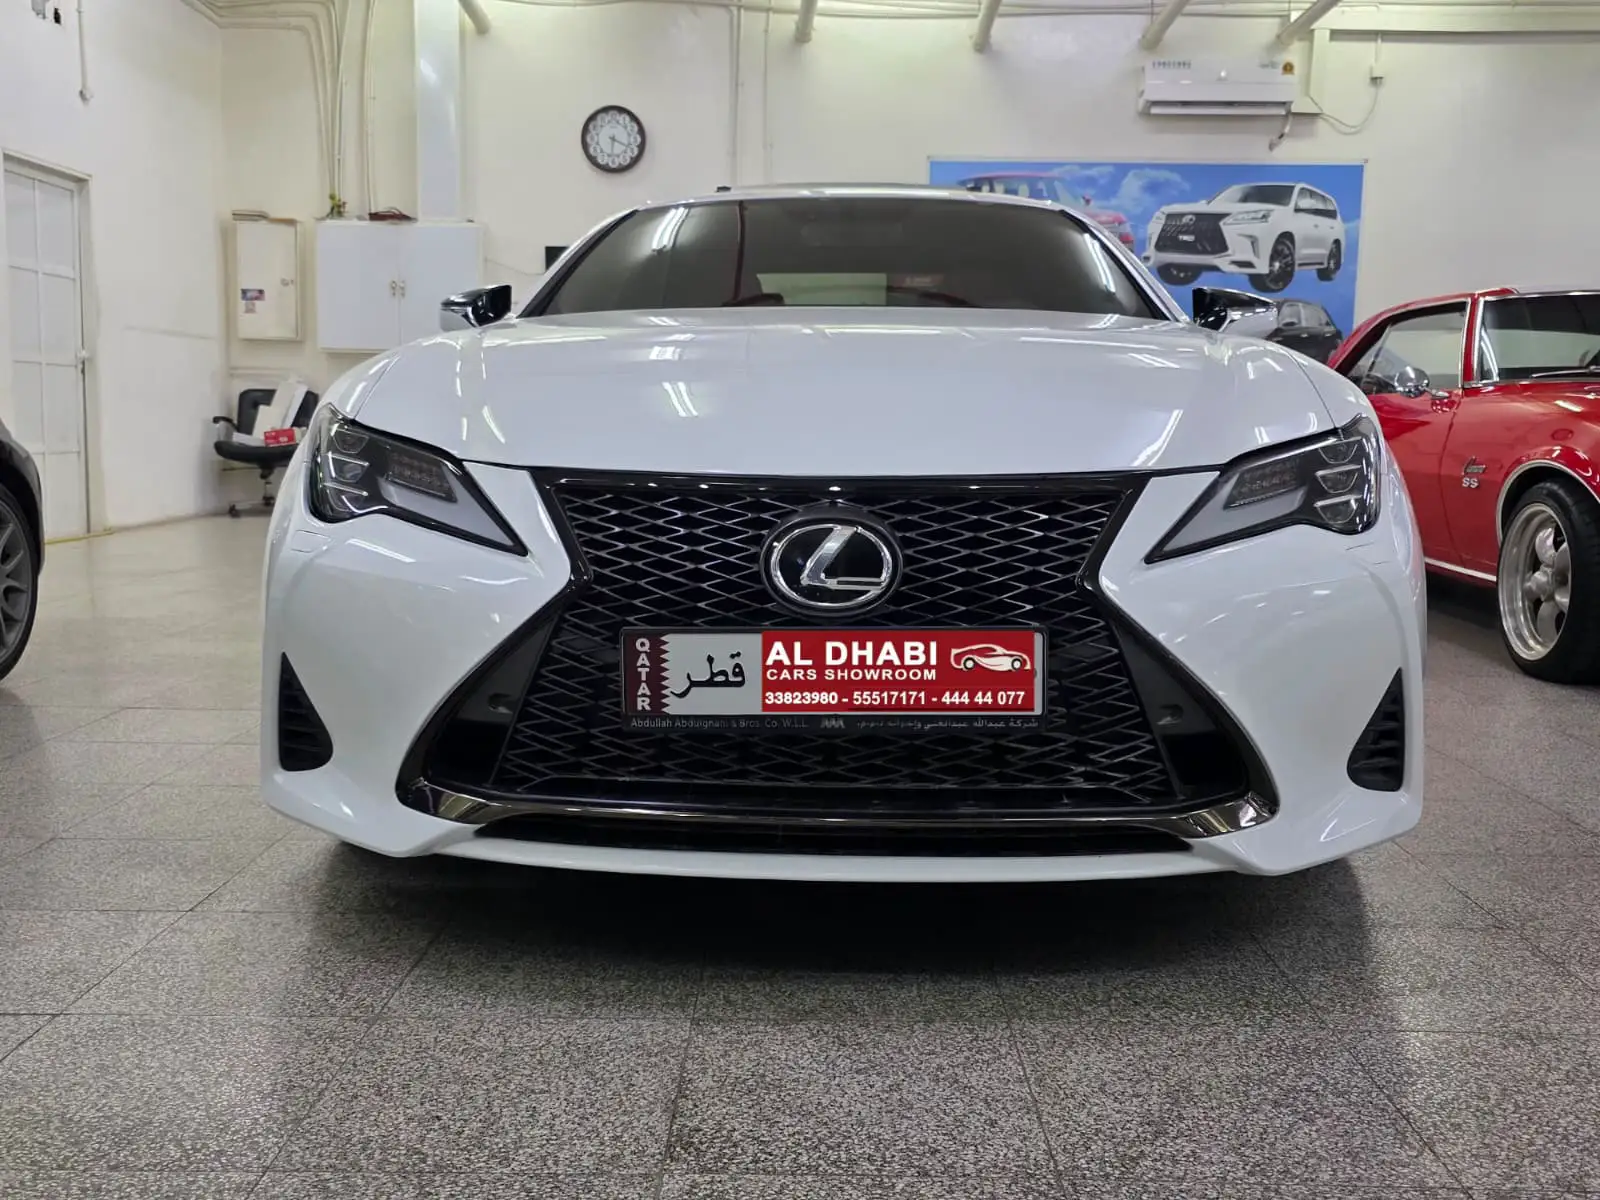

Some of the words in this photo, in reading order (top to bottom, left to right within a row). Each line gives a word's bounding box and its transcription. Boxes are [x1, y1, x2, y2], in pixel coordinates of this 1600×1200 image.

[1462, 477, 1480, 488] SS
[765, 640, 813, 666] AL
[825, 640, 937, 666] DHABI
[635, 638, 651, 711] QATAR
[670, 651, 746, 699] قطر
[766, 668, 817, 681] CARS
[824, 668, 937, 681] SHOWROOM
[764, 691, 838, 705] 33823980
[852, 691, 926, 705] 55517171
[941, 691, 970, 705] 444
[974, 691, 993, 705] 44
[997, 691, 1026, 705] 077
[630, 717, 672, 728] Abdullah
